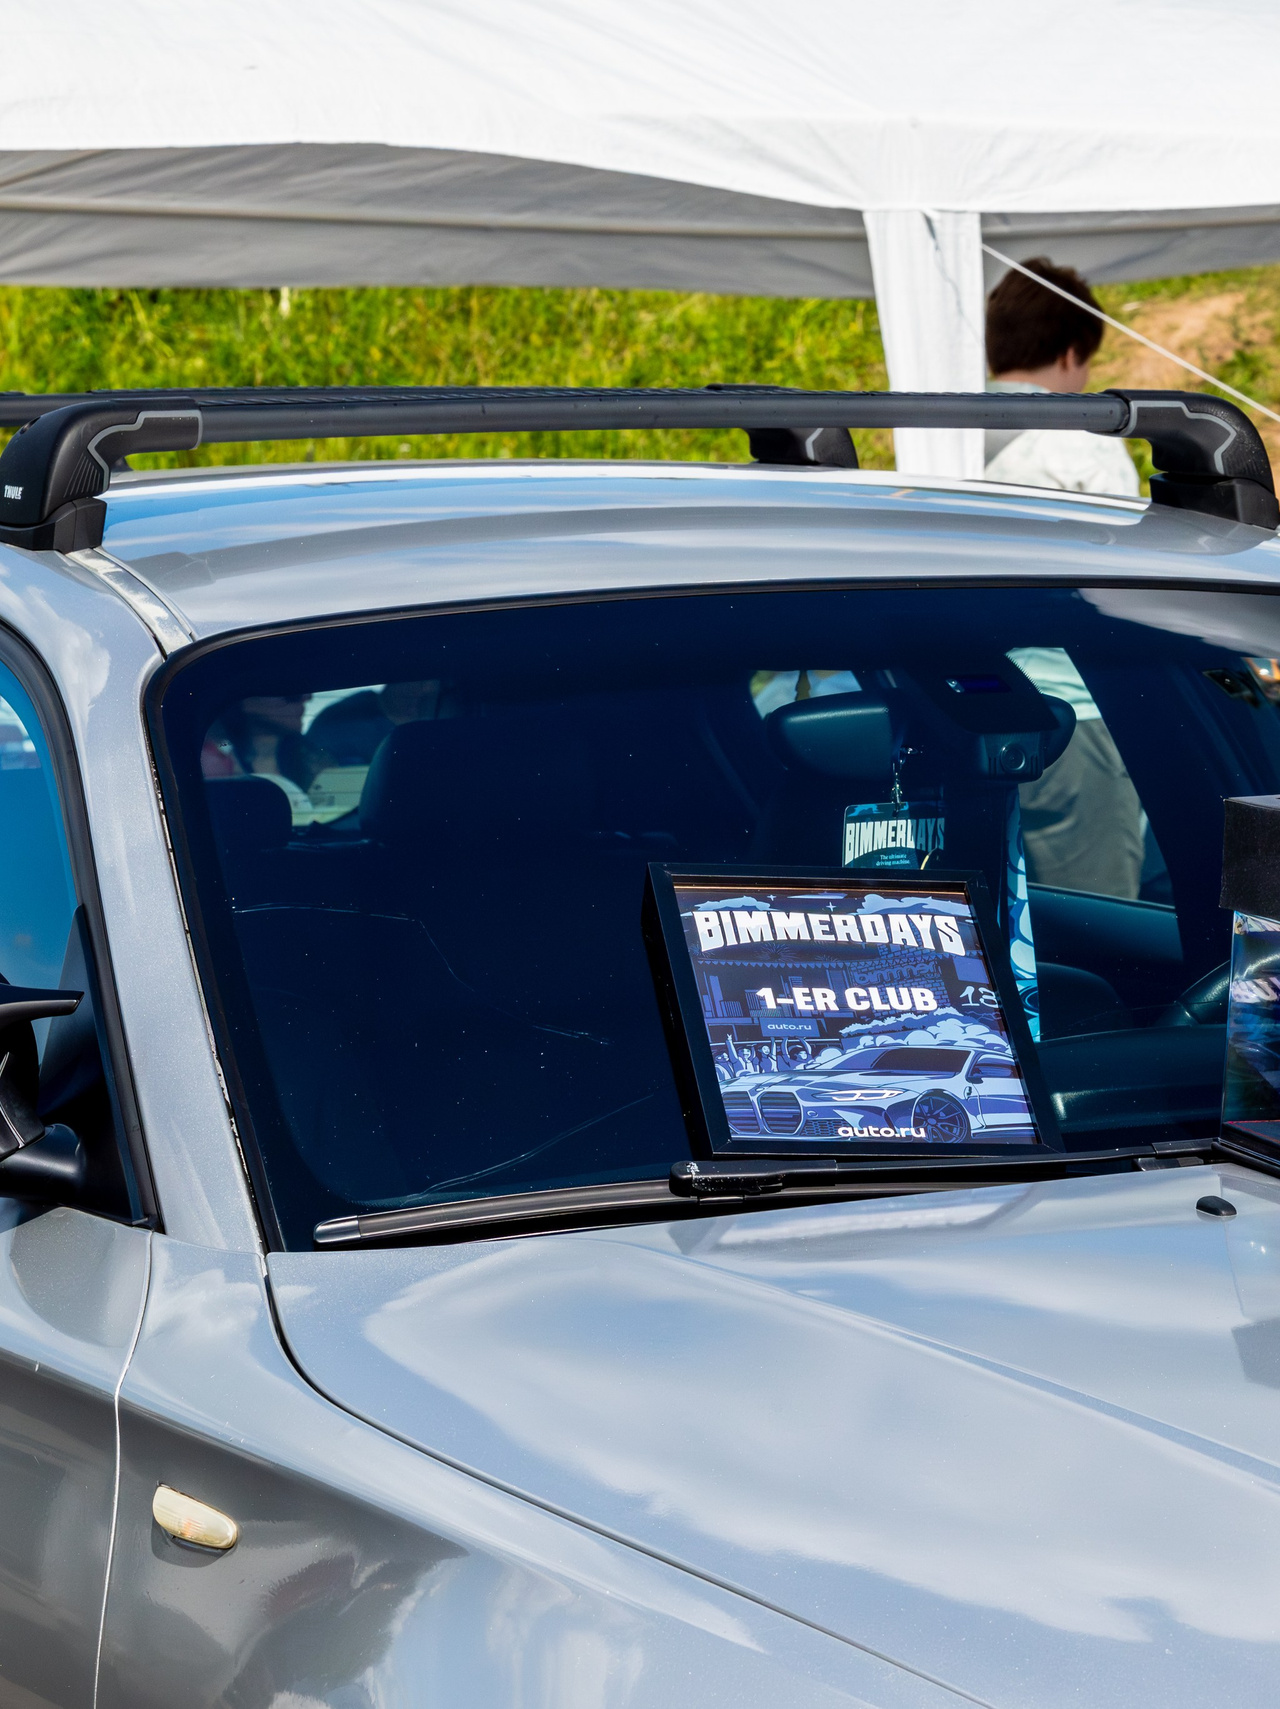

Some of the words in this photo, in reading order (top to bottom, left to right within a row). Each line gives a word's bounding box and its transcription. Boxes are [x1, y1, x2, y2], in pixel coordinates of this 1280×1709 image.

[4, 485, 23, 500] THULE
[845, 818, 945, 866] BIMMERDAYS
[692, 910, 966, 957] BIMMERDAYS
[756, 987, 840, 1012] 1-ER
[844, 987, 938, 1012] CLUB
[767, 1023, 812, 1031] auto.ru
[837, 1125, 926, 1138] auto.ru
